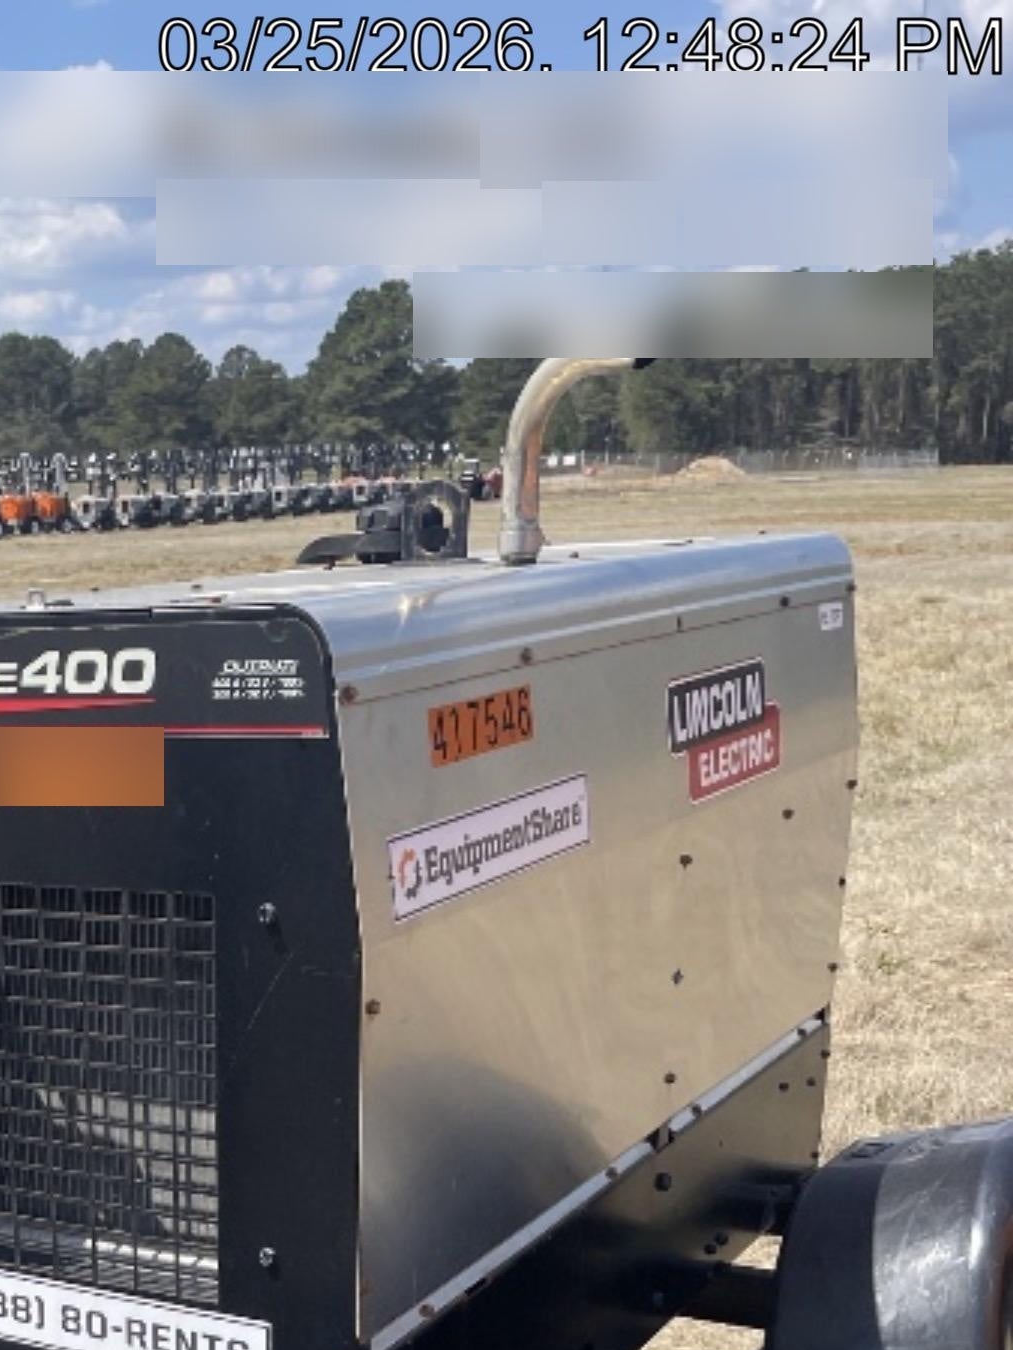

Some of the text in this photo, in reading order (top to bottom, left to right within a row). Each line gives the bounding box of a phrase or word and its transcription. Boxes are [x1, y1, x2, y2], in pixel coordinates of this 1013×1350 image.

[433, 687, 532, 761] 417546
[672, 671, 763, 743] LINCOLN
[698, 728, 774, 787] ELECTRIC
[423, 801, 582, 885] EquipmentShare
